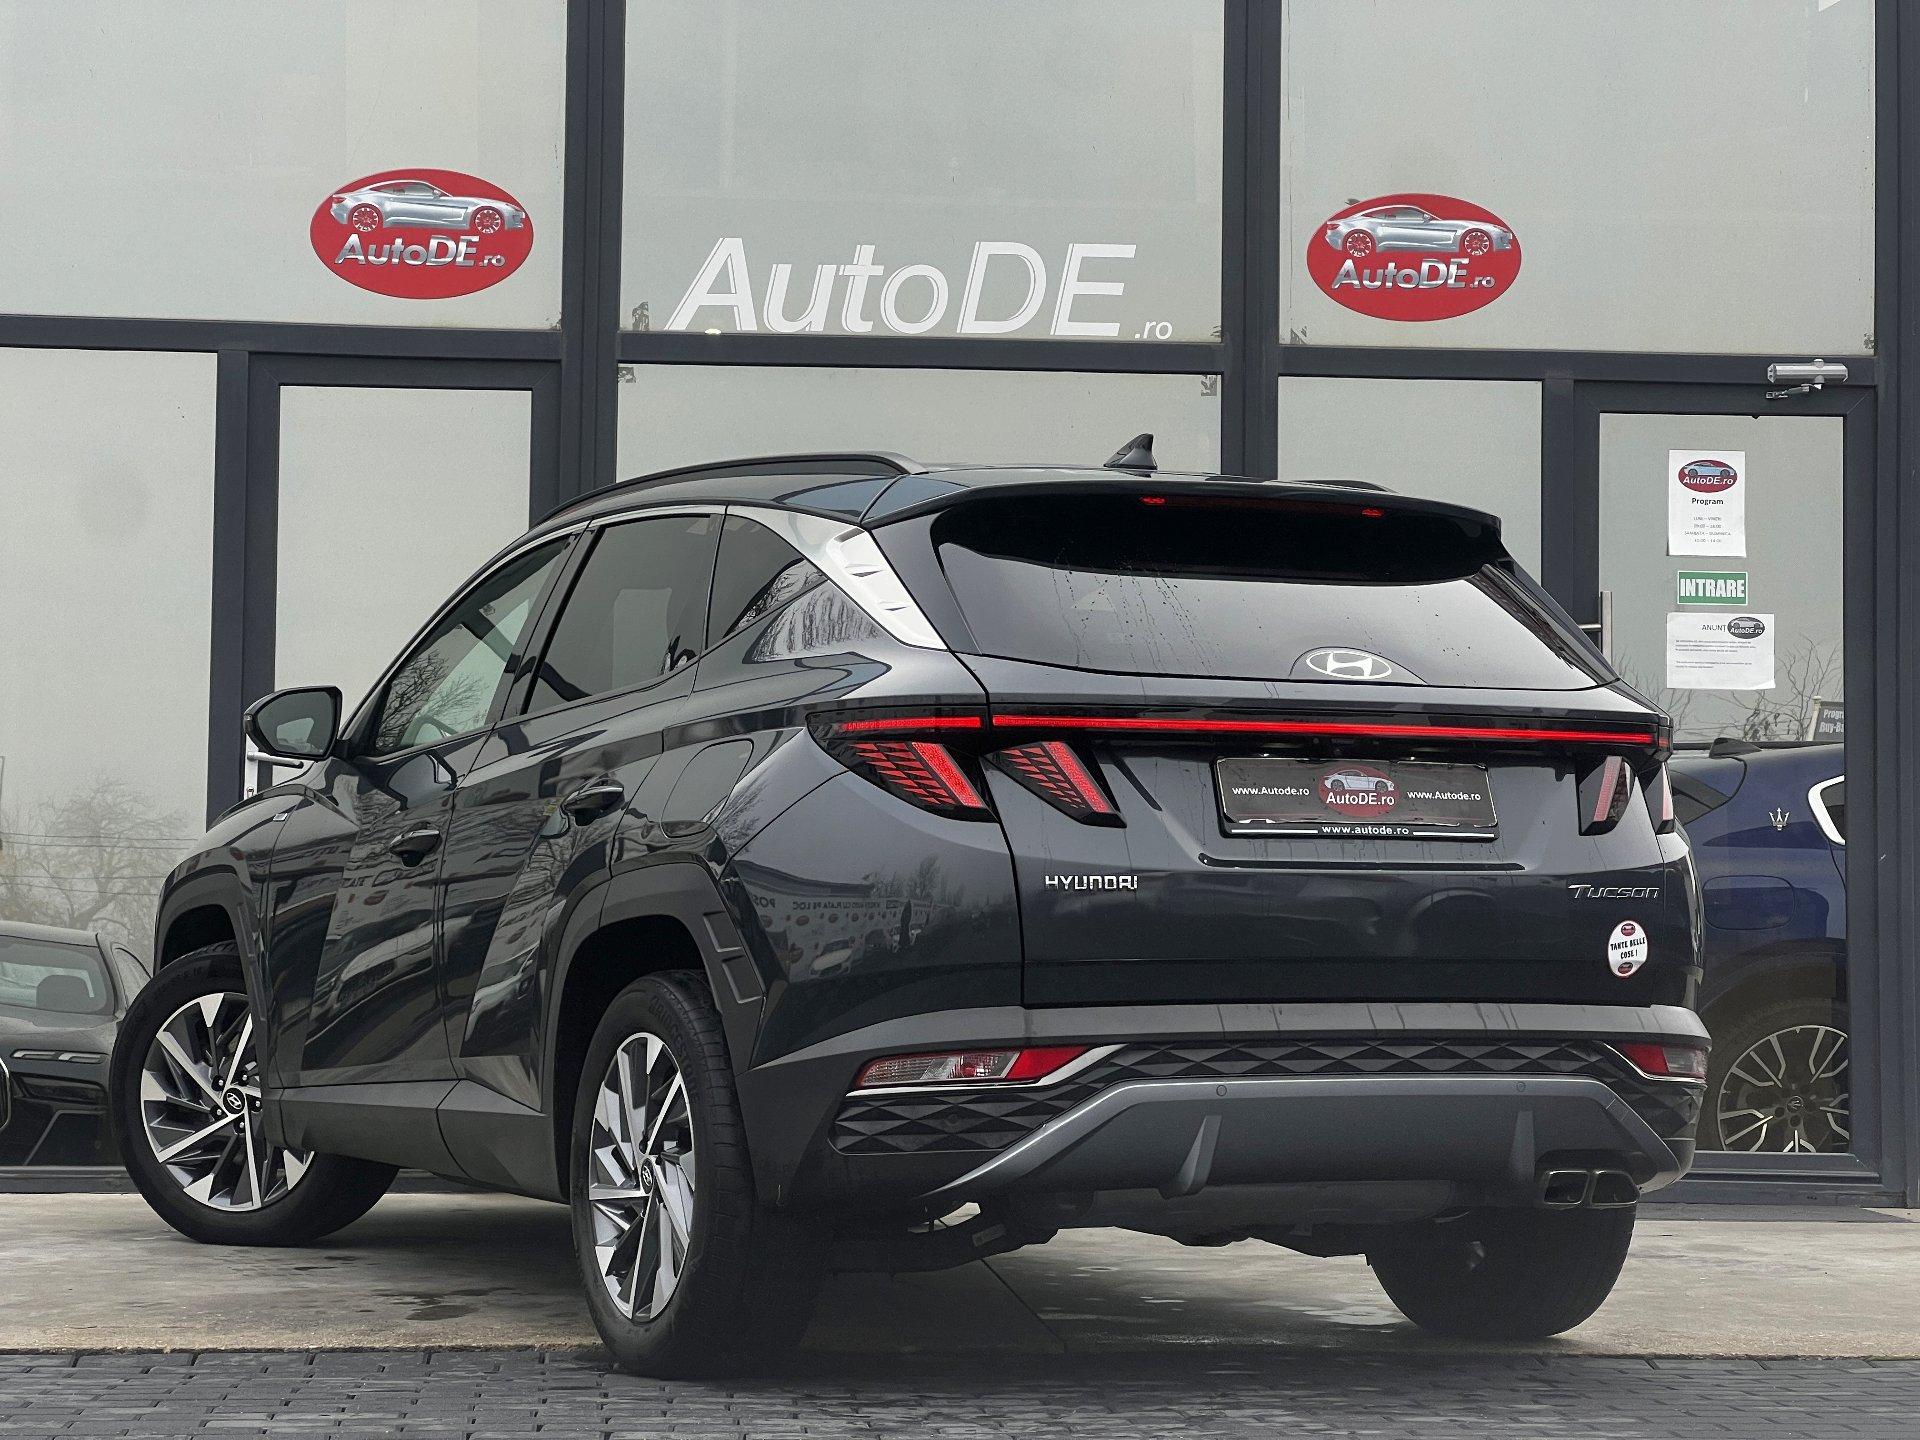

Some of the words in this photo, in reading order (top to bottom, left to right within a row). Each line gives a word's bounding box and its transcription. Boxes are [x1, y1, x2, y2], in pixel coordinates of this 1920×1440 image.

[1683, 476, 1734, 486] AutoDE.ro
[1691, 497, 1724, 506] Program
[1680, 578, 1745, 598] INTRARE
[1231, 786, 1310, 796] www.Autode.ro
[1407, 790, 1482, 801] www.Autode.ro
[1326, 792, 1395, 806] AutoDE.ro
[1321, 825, 1410, 836] www.autode.ro
[1044, 875, 1138, 890] HYUNDAI
[1629, 937, 1646, 948] BELLE
